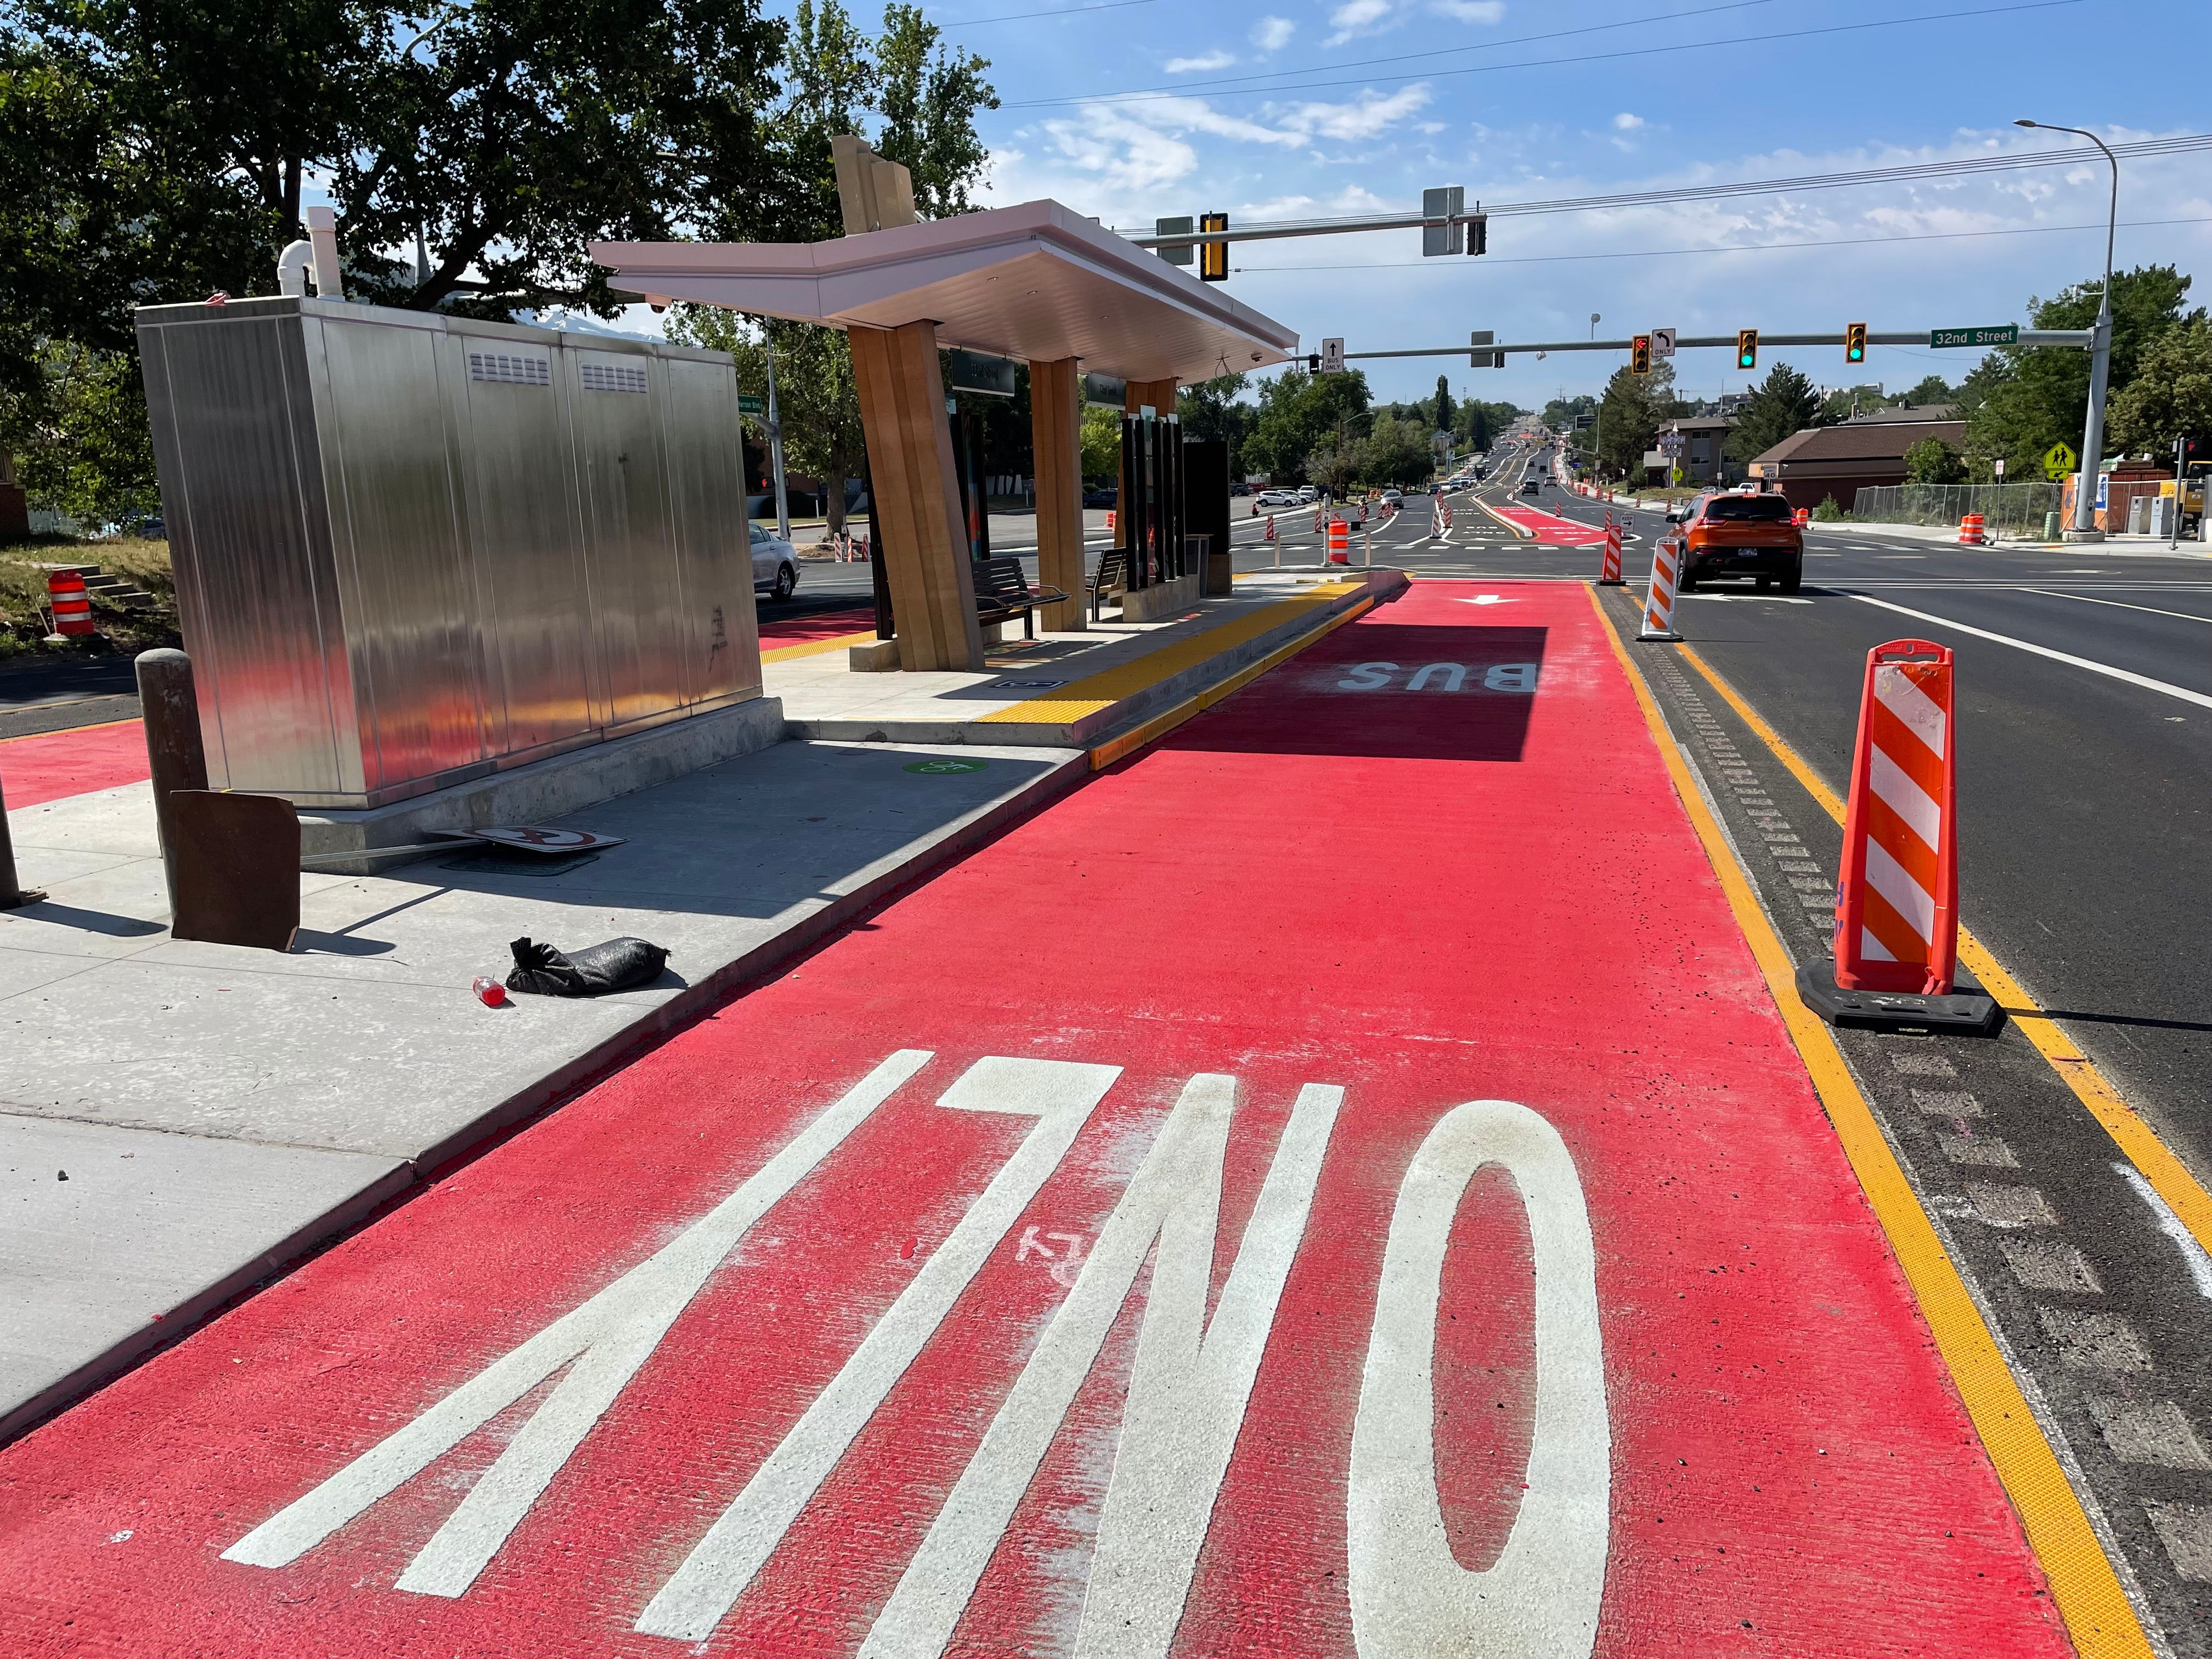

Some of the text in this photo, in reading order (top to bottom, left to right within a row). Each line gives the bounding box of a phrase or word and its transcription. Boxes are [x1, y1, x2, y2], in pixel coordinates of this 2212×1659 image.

[1936, 330, 2013, 345] 32nd Street
[1338, 662, 1537, 693] BUS
[221, 1048, 1611, 1659] ONLY
